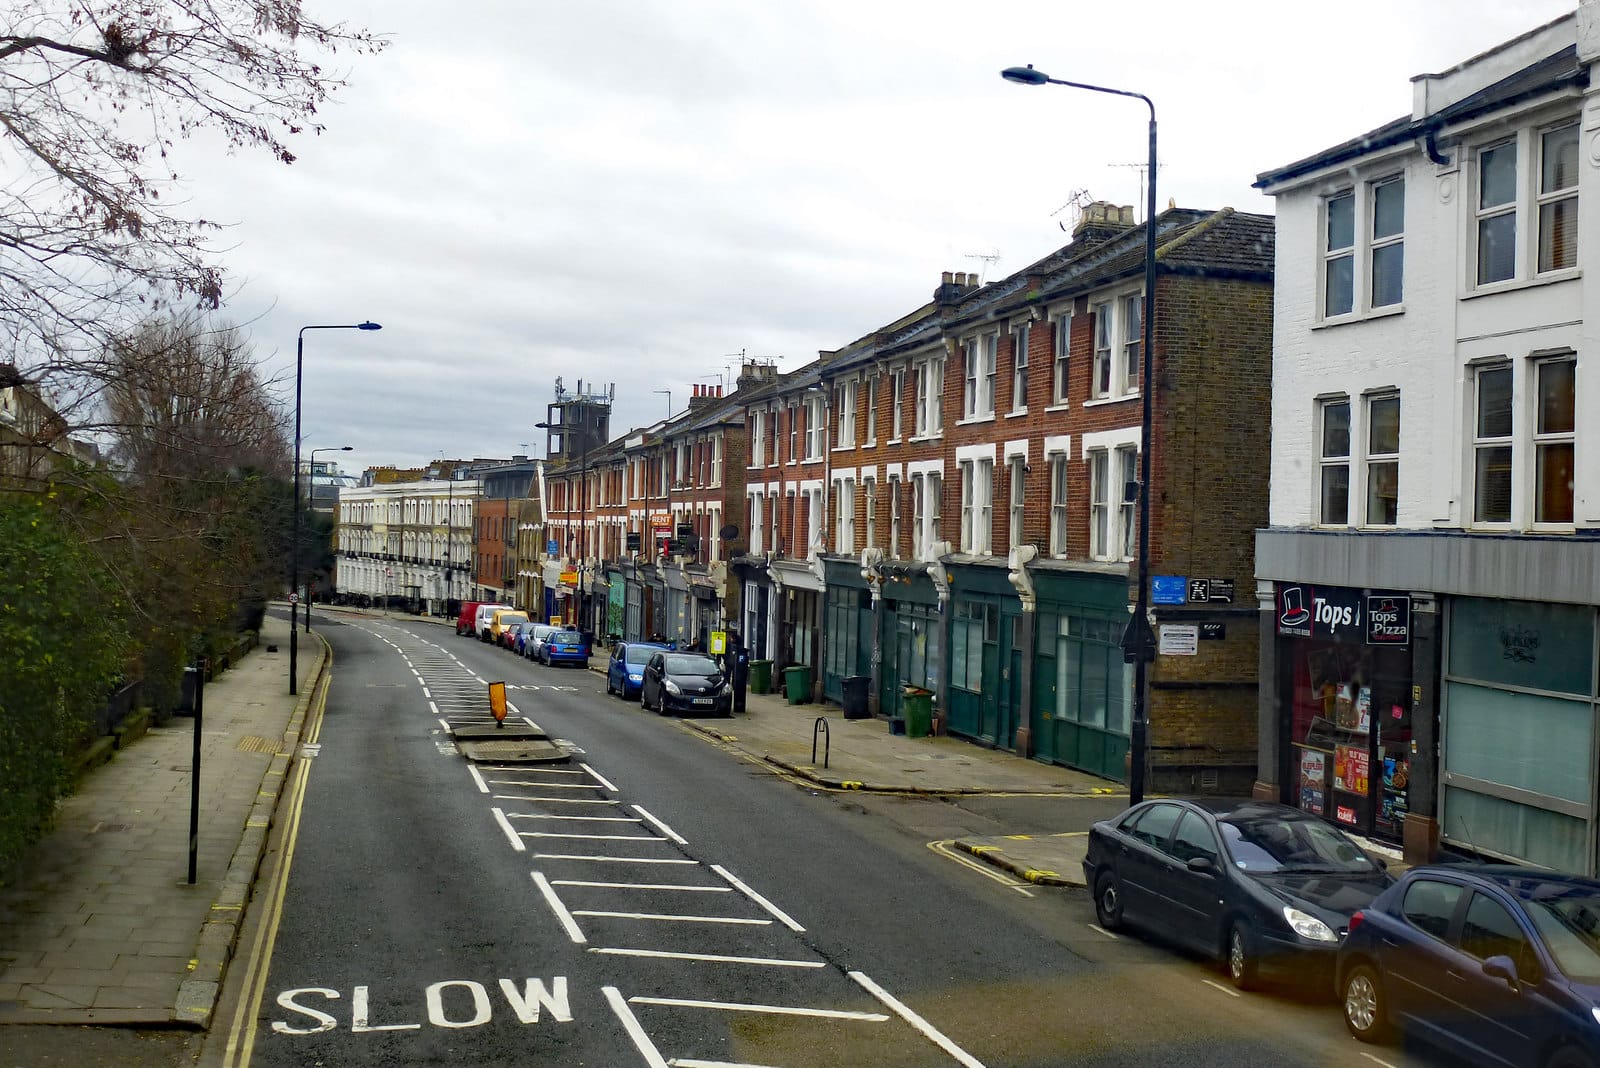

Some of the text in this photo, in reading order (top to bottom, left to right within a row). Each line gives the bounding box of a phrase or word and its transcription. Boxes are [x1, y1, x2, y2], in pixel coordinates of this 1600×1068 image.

[1314, 598, 1352, 634] Tops
[1370, 611, 1397, 626] Tops
[1374, 623, 1407, 635] Pizza
[271, 976, 575, 1034] SLOW
